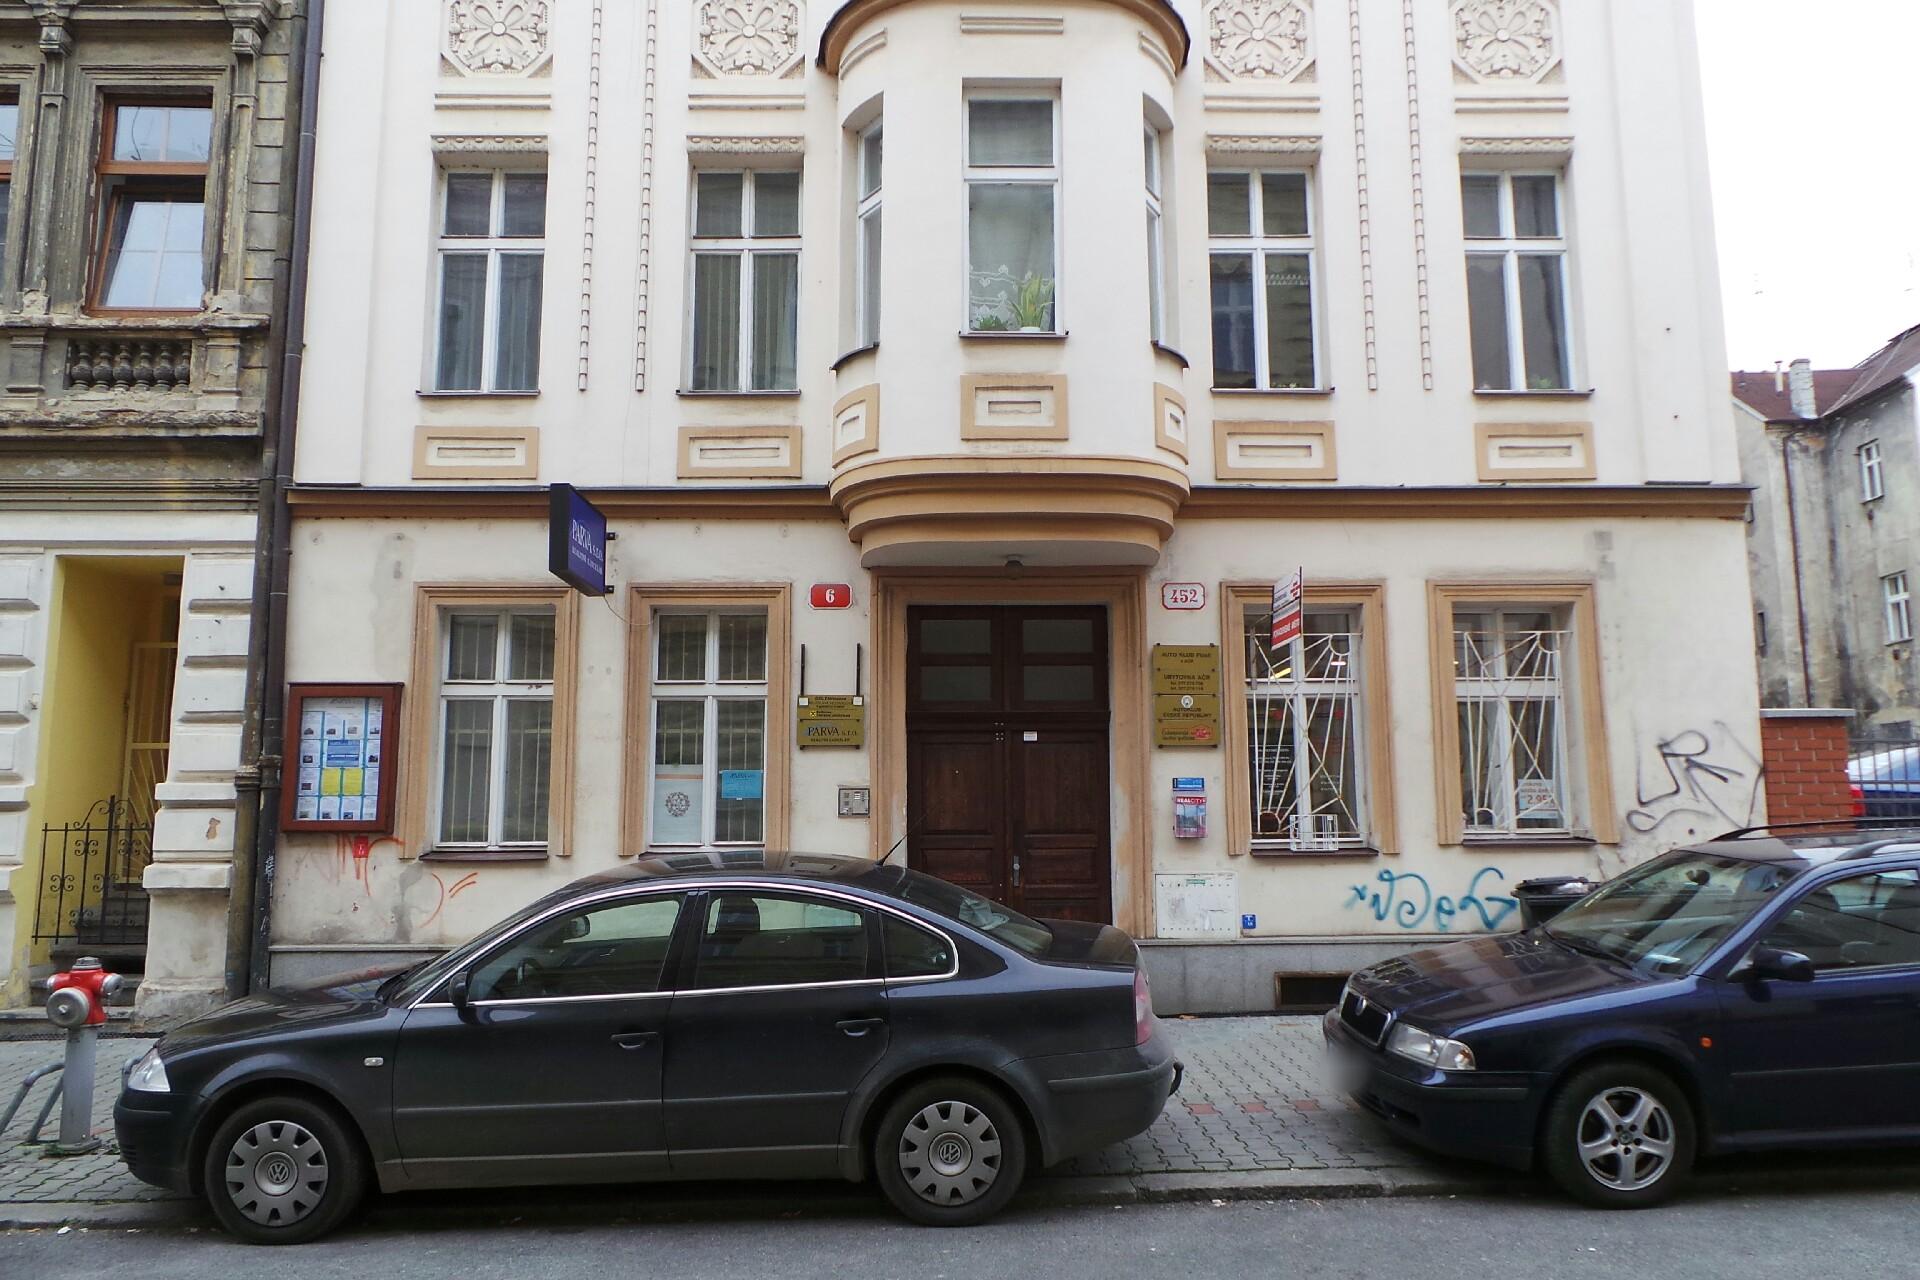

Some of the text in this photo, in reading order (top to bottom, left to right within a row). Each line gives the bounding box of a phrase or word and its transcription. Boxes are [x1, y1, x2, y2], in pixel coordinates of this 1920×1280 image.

[572, 519, 592, 554] PARVA
[825, 588, 835, 603] 6
[1170, 589, 1198, 603] 452
[808, 727, 840, 736] PARVA
